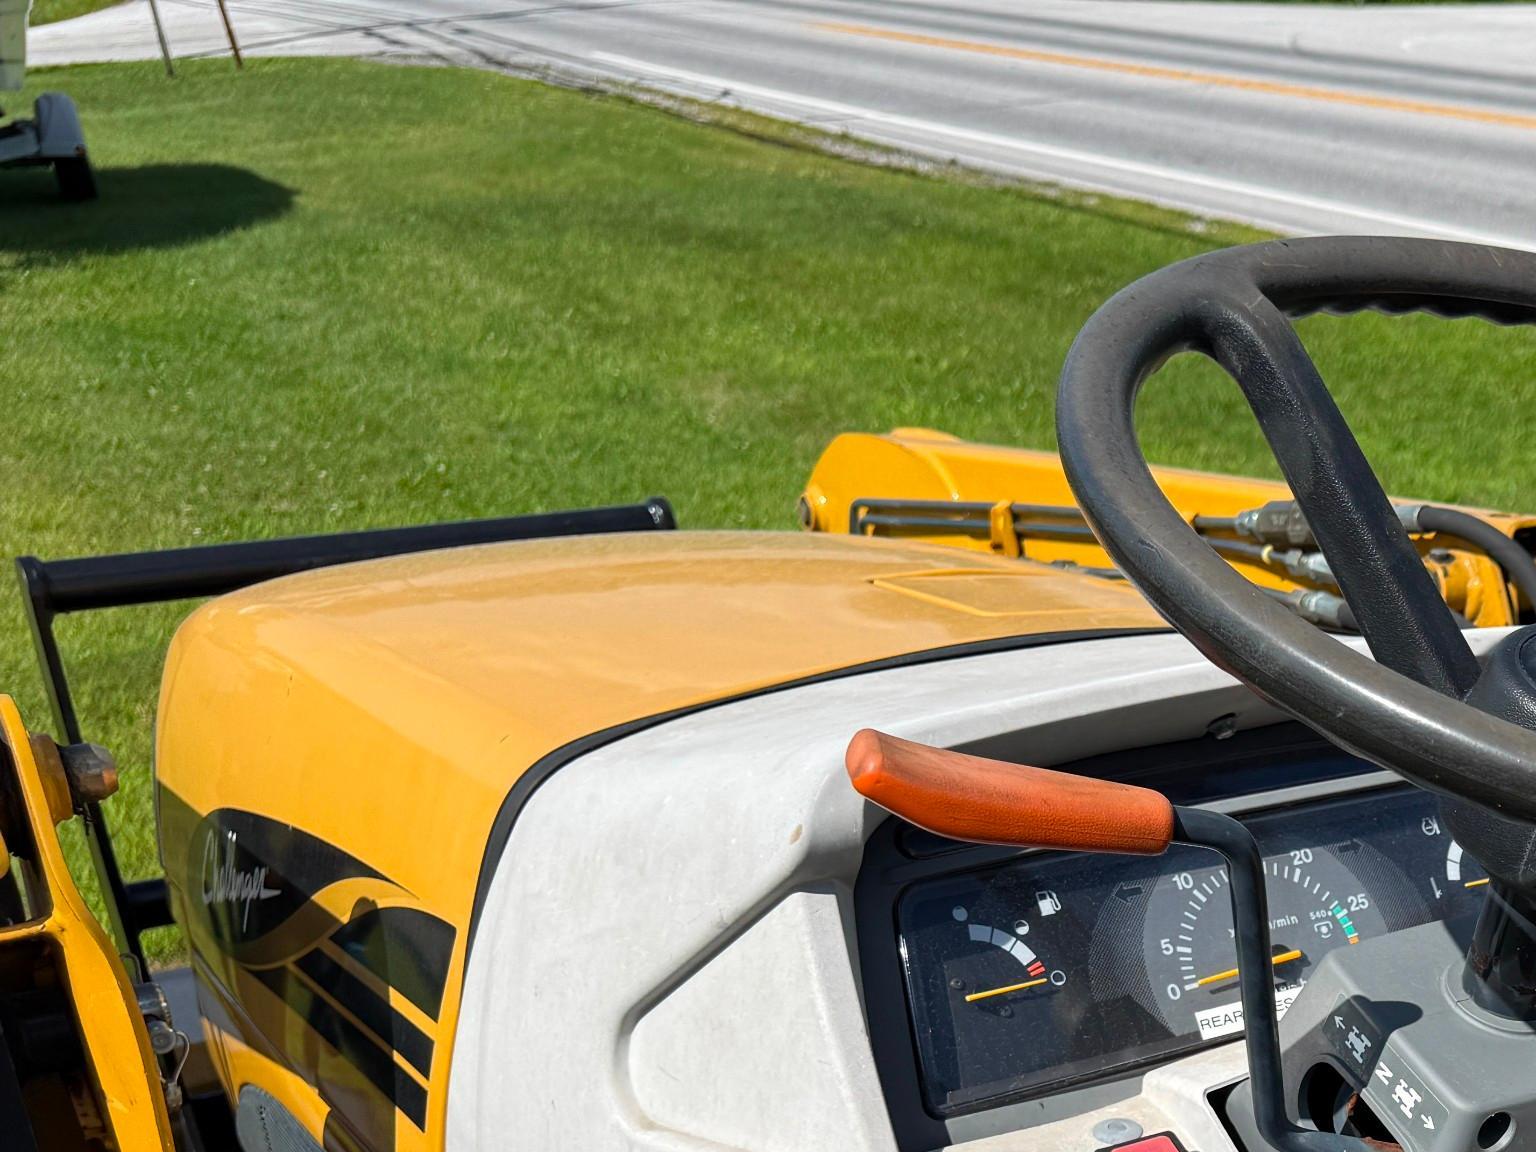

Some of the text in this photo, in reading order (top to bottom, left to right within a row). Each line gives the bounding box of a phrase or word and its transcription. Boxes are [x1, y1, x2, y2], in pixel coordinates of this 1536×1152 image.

[1290, 848, 1313, 866] 20
[201, 828, 282, 934] Challenger
[1172, 872, 1194, 890] 10
[1347, 893, 1369, 911] 25
[1160, 938, 1174, 955] 5
[1167, 983, 1181, 1000] 0
[1199, 1009, 1244, 1031] REAR
[1375, 1061, 1393, 1086] N
